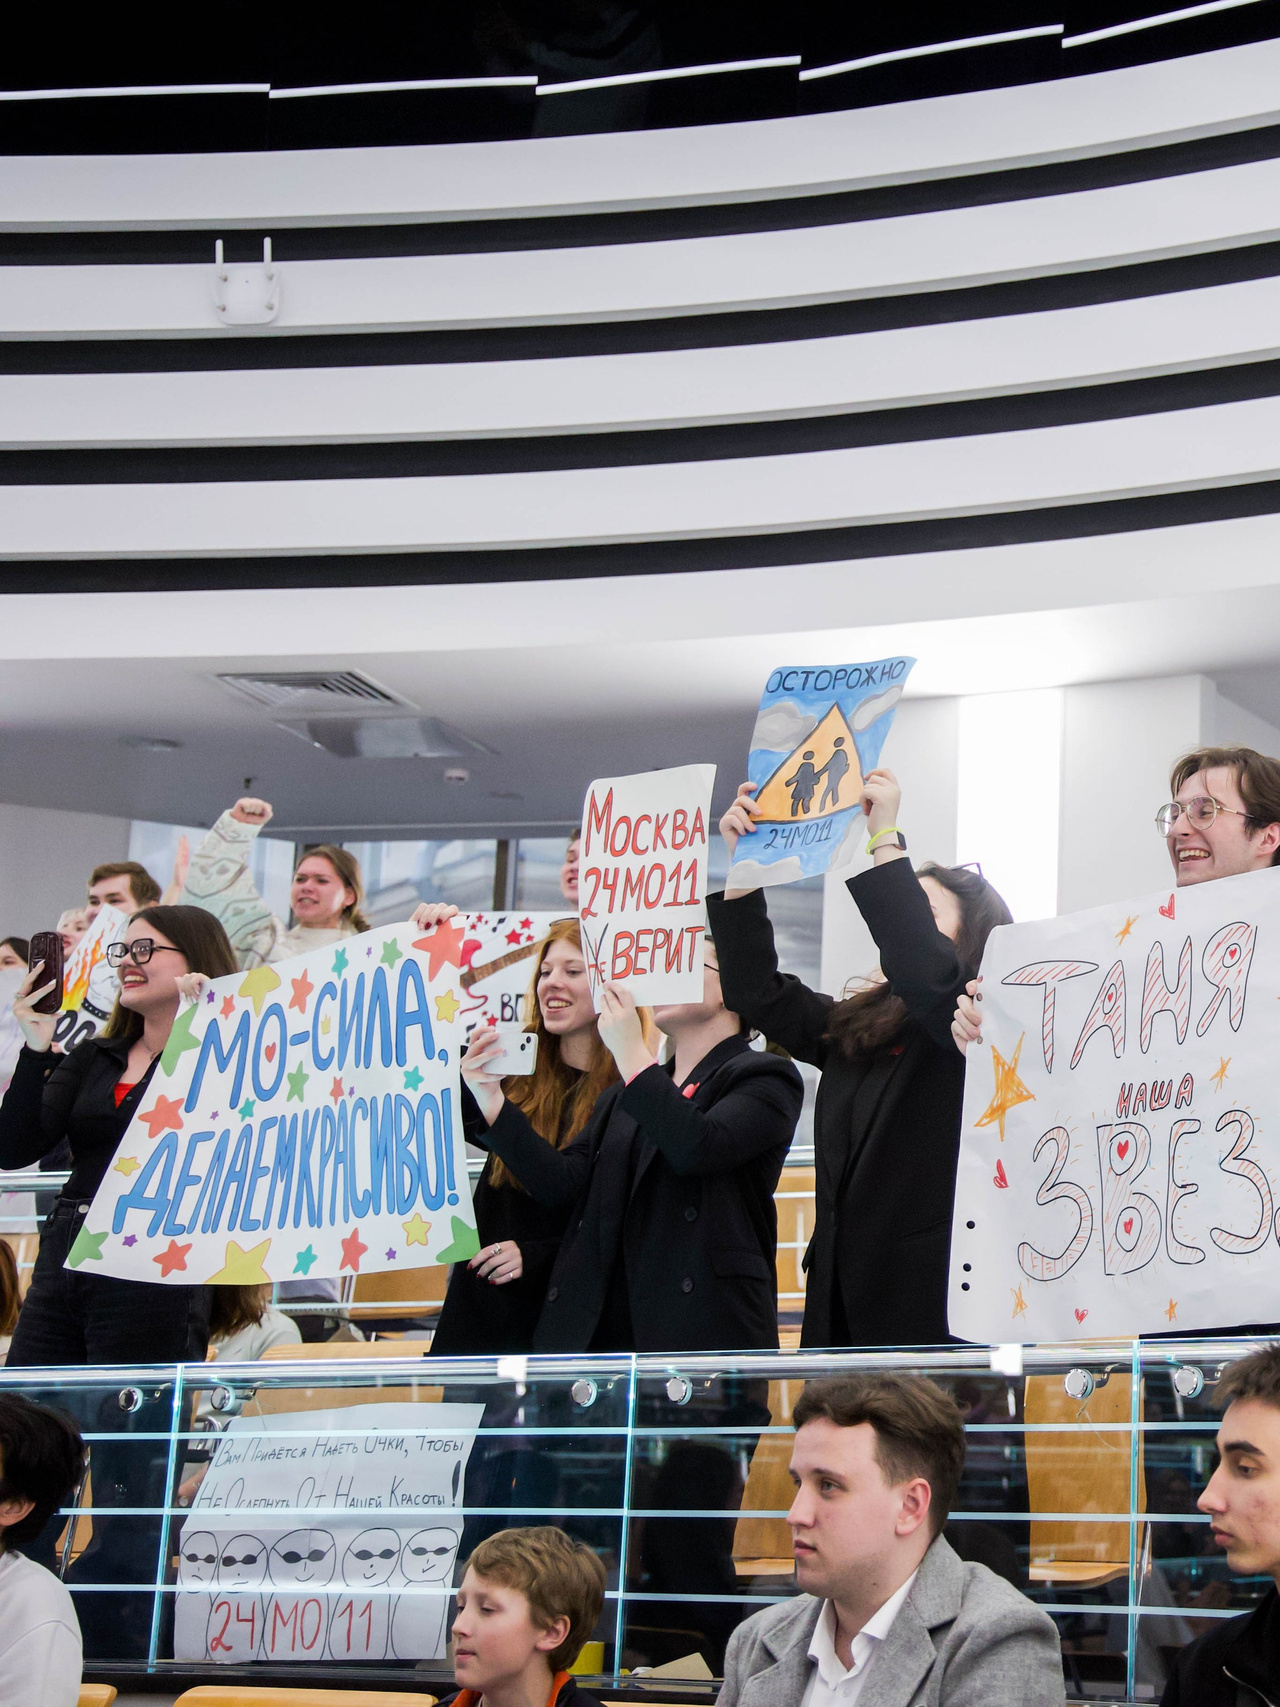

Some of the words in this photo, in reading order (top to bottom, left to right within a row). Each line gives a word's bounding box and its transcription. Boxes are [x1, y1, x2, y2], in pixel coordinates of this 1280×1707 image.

[766, 659, 906, 693] ОСТОРОЖНО
[763, 820, 832, 850] 24МО11
[583, 858, 701, 921] 24МО11
[611, 926, 705, 980] ВЕРИТ
[1001, 921, 1258, 1073] ТАНЯ
[184, 957, 449, 1114] МО-СИЛА,
[1116, 1072, 1194, 1119] НАША
